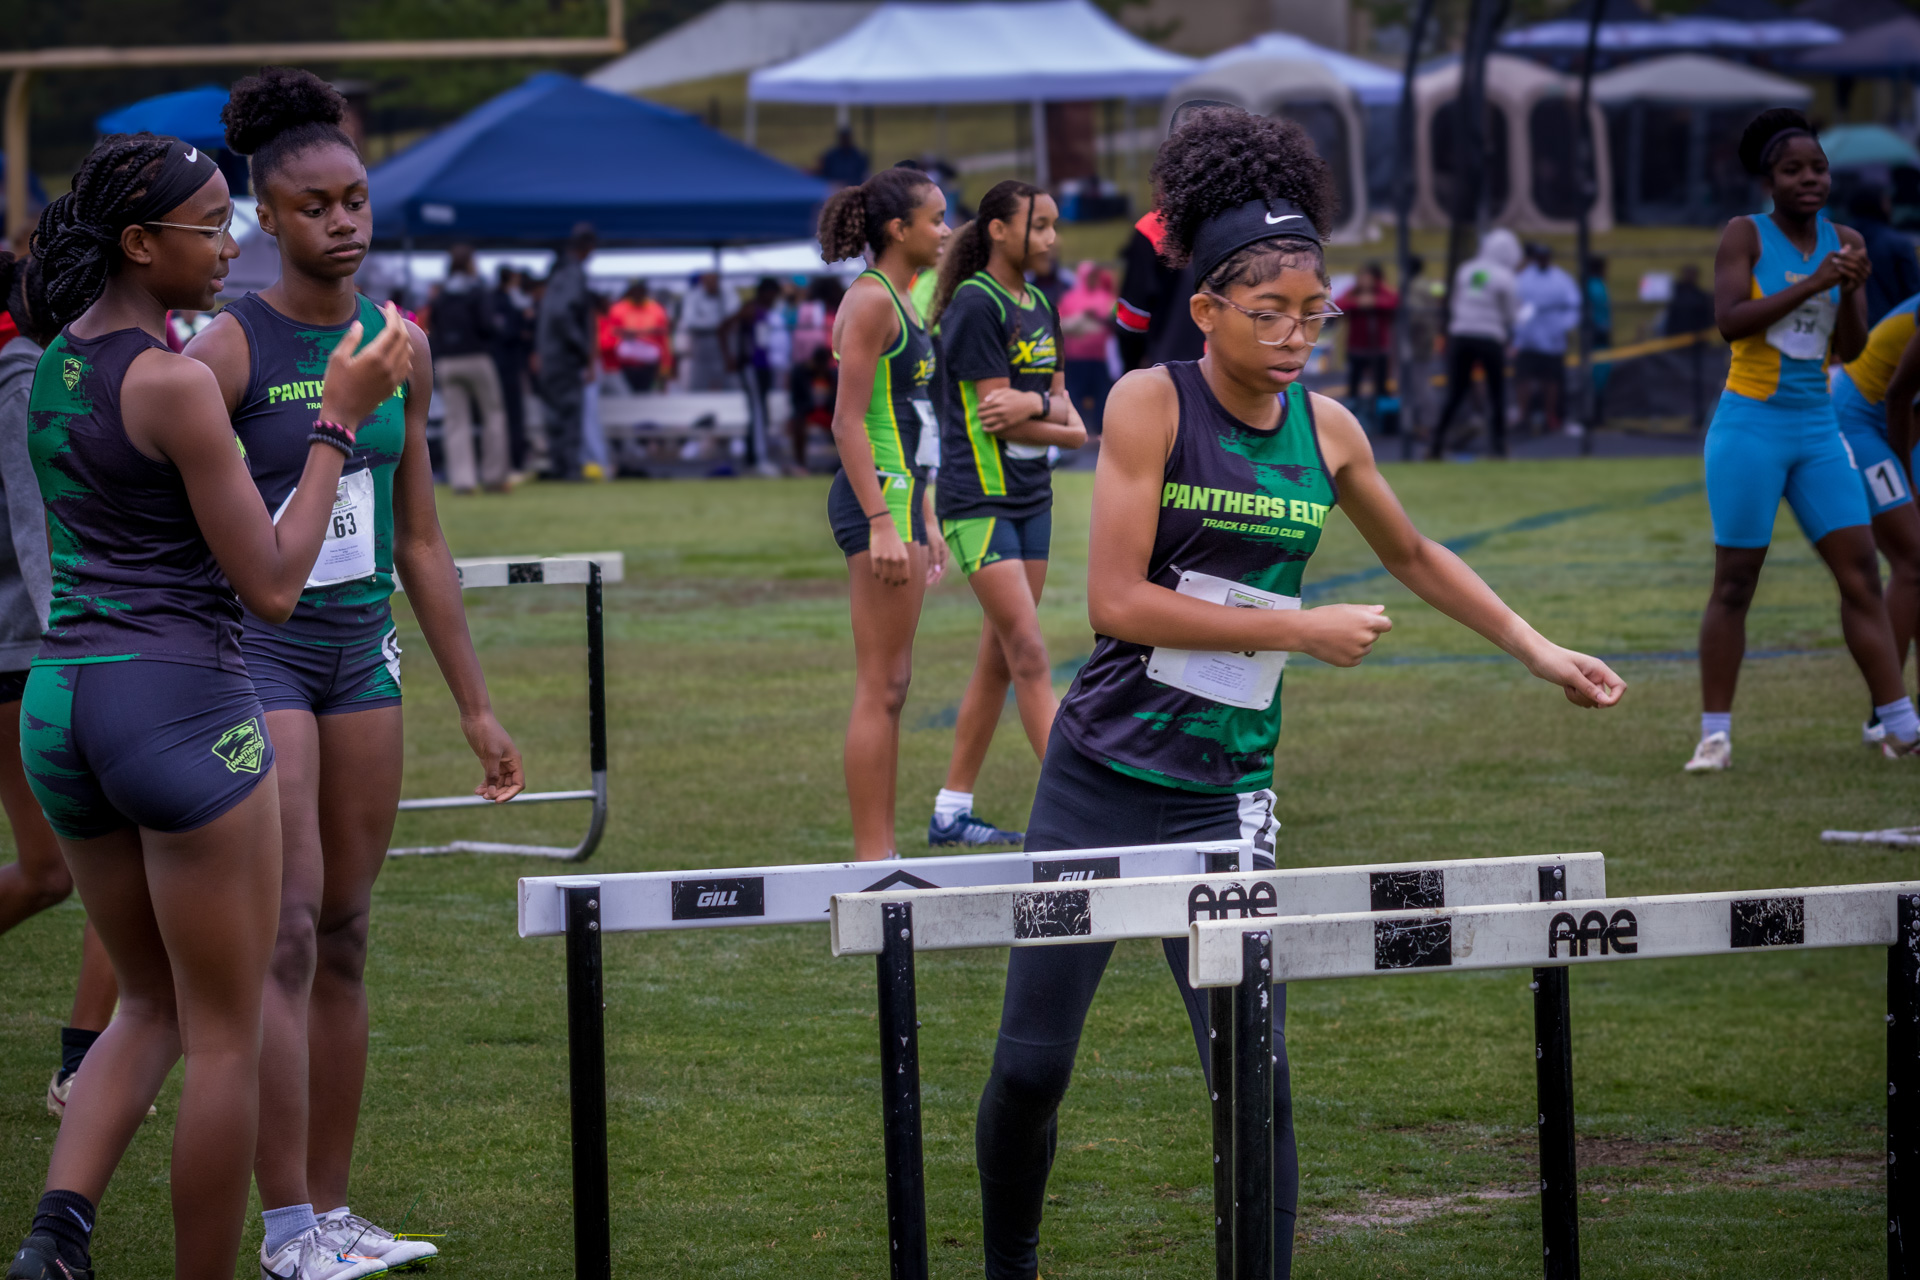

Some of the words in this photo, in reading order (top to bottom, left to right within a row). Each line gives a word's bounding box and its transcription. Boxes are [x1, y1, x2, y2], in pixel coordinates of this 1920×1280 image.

[268, 380, 325, 404] PANTH
[1161, 482, 1286, 519] PANTHERS
[1289, 499, 1331, 530] ELIT
[1202, 518, 1239, 532] TRACK
[1239, 523, 1249, 532] &
[1249, 523, 1279, 536] FIELD
[1279, 528, 1306, 539] CLUB
[230, 740, 263, 769] PANTHERS
[696, 890, 738, 908] GILL
